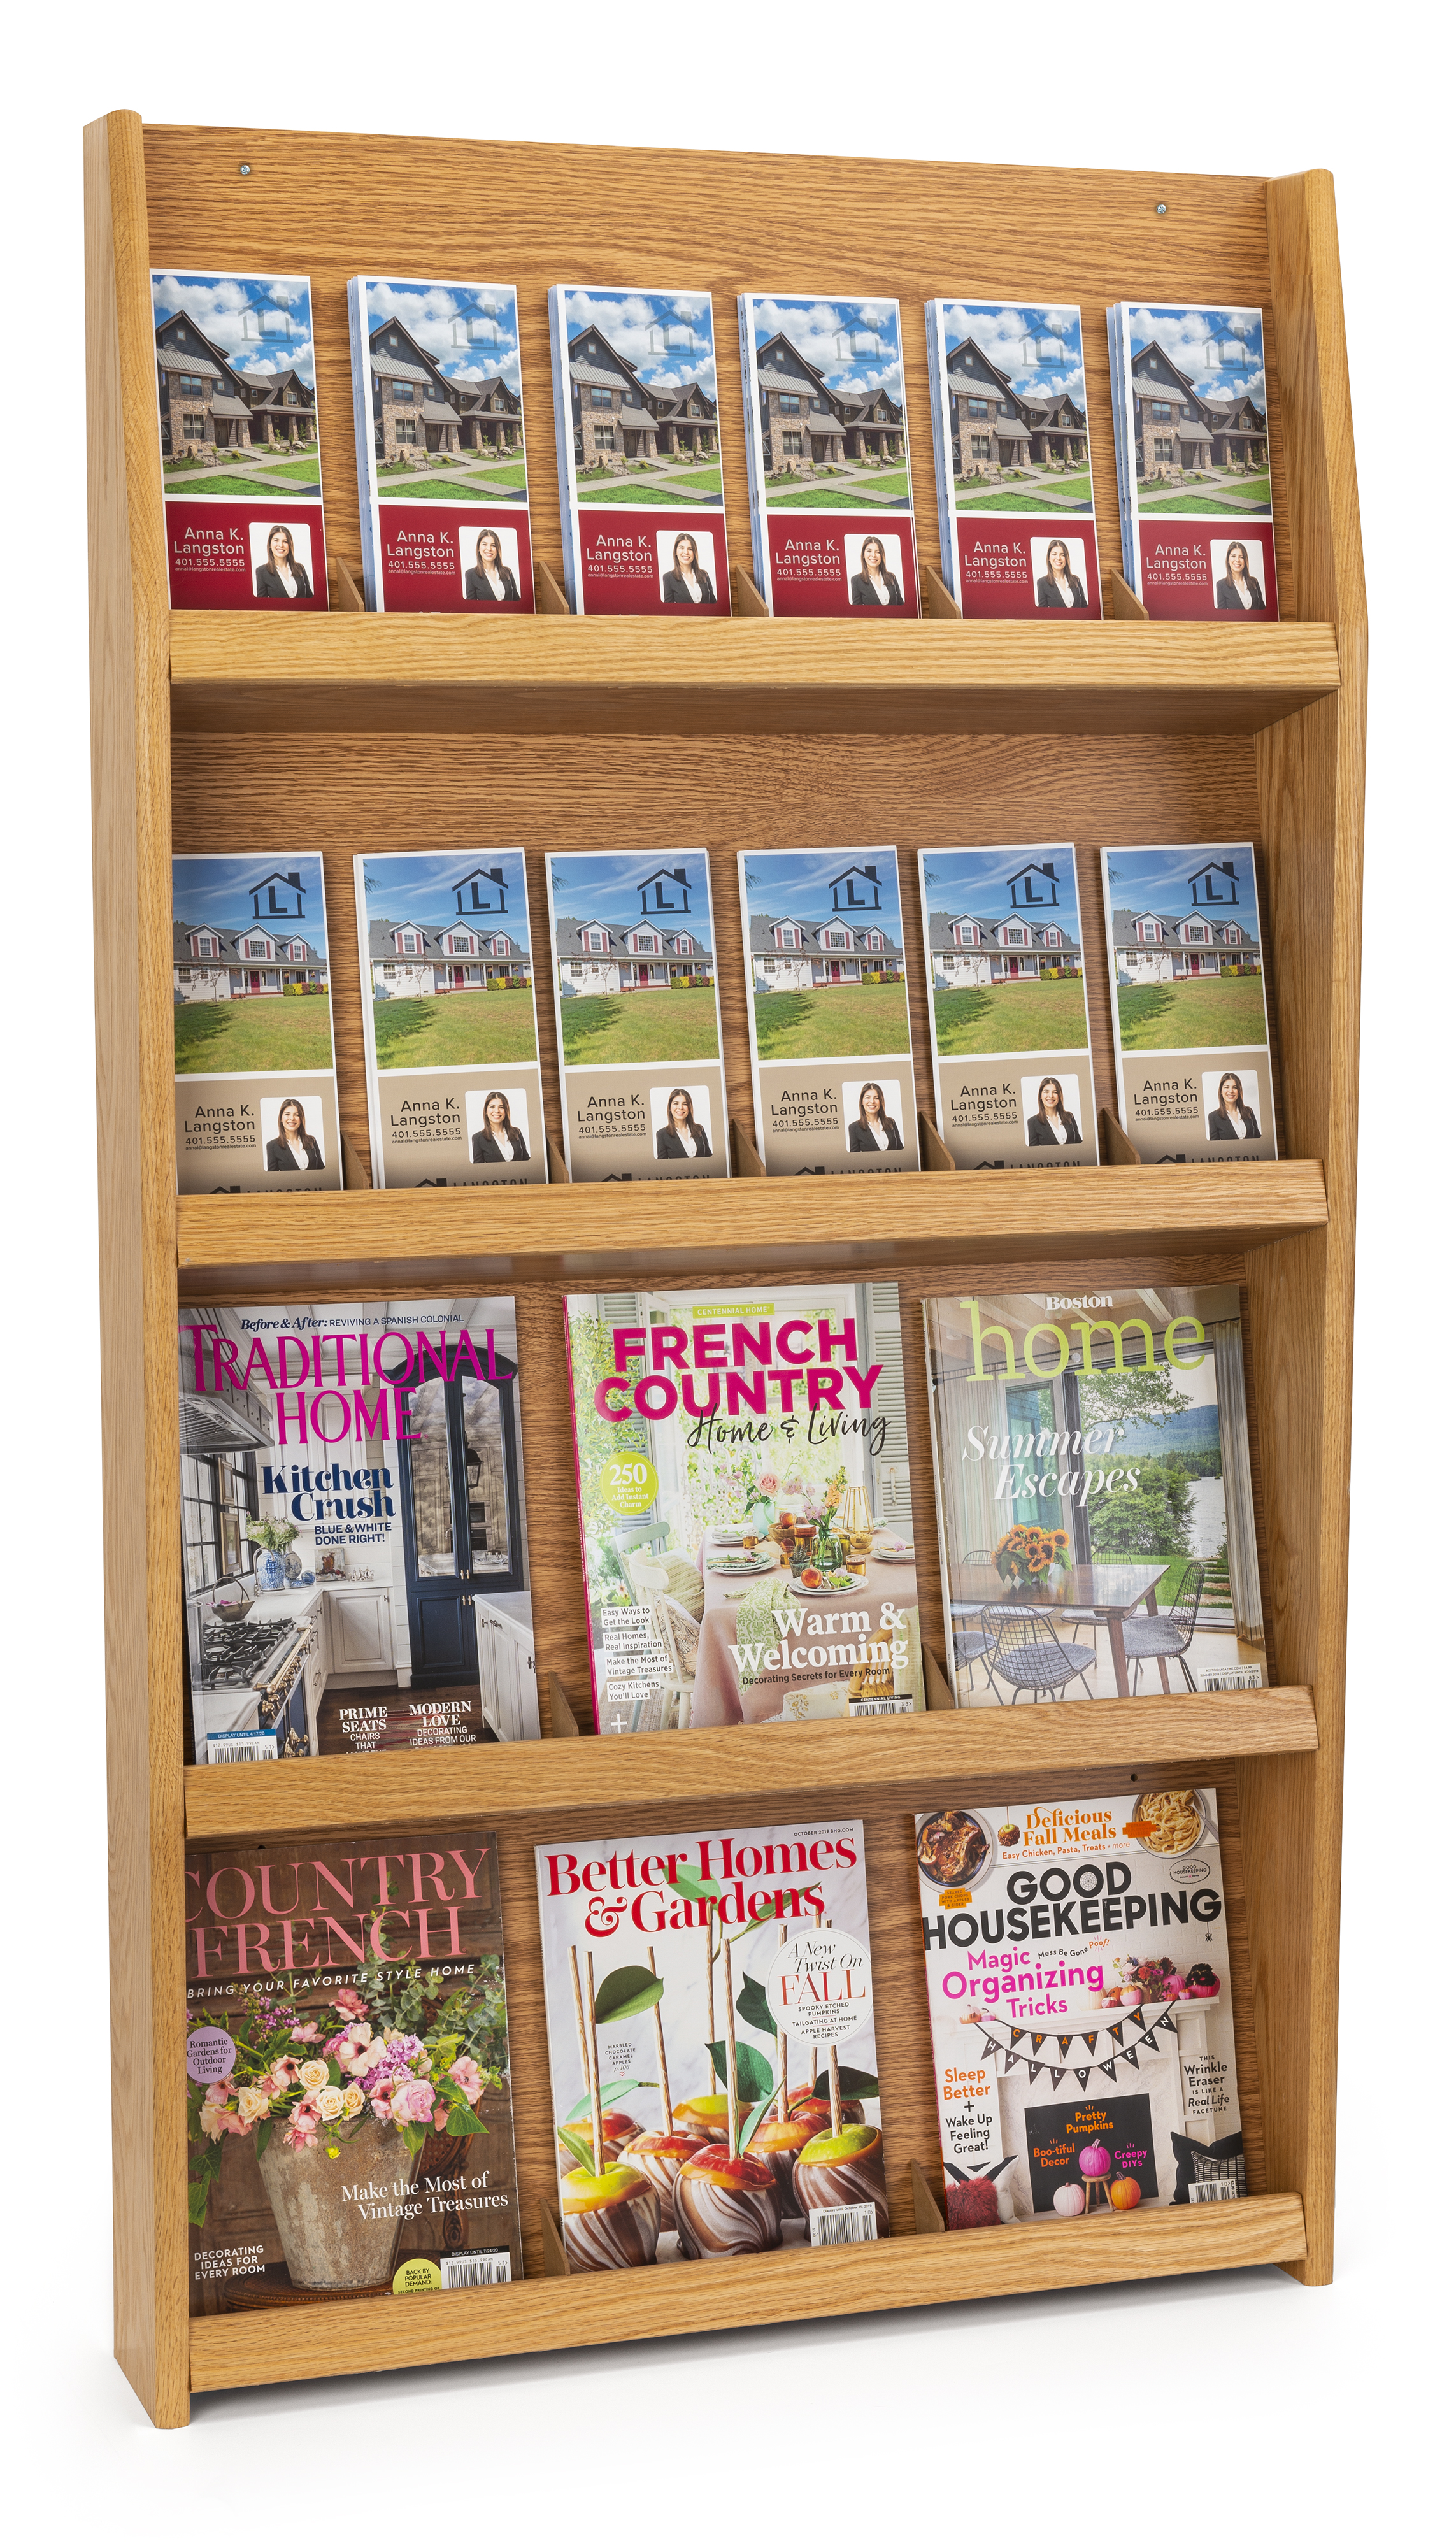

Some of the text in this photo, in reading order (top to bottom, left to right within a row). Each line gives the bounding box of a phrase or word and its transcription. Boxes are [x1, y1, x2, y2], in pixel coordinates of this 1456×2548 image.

[185, 527, 243, 540] Anna K.
[175, 541, 245, 555] Langston
[785, 540, 839, 551] Anna K.
[1155, 544, 1206, 556] Anna K.
[175, 558, 245, 567] 401.555.5555
[776, 552, 840, 566] Langston
[1146, 557, 1206, 571] Langston
[1143, 1079, 1197, 1092] Anna K.
[587, 1094, 645, 1108] Anna K.
[1134, 1091, 1198, 1106] Langston
[194, 1104, 255, 1119] Anna K.
[577, 1108, 645, 1124] Langston
[1135, 1107, 1198, 1117] 401.555.5555
[184, 1118, 255, 1135] Langston
[578, 1124, 645, 1134] 401.555.5555
[185, 1134, 255, 1145] 401.555.5555
[1046, 1296, 1113, 1310] Boston
[240, 1318, 279, 1332] Before
[281, 1317, 290, 1329] &
[291, 1317, 328, 1330] After:
[329, 1317, 370, 1327] REVIVING
[381, 1315, 418, 1326] SPANISH
[421, 1314, 464, 1324] COLONIAL
[613, 1318, 858, 1372] FRENCH
[960, 1301, 1205, 1382] home
[178, 1324, 513, 1391] TRADITIONAL
[594, 1364, 883, 1422] COUNTRY
[275, 1387, 421, 1445] HOME
[687, 1403, 892, 1456] Home & Living
[962, 1426, 1124, 1461] Summer
[261, 1462, 394, 1495] Kitchen
[609, 1463, 647, 1485] 250
[990, 1464, 1141, 1507] Escapes
[291, 1490, 396, 1521] Crush
[315, 1522, 392, 1534] BLUE & WHITE
[315, 1533, 385, 1545] DONE RIGHT!
[771, 1603, 906, 1638] Warm &
[728, 1633, 908, 1673] Welcoming
[743, 1666, 890, 1685] Decorating Secrets for Every Room
[339, 1707, 387, 1720] PRIME
[409, 1701, 471, 1715] MODERN
[342, 1719, 386, 1733] SEATS
[422, 1714, 460, 1727] LOVE
[350, 1732, 380, 1741] CHAIRS
[1026, 1807, 1111, 1829] Delicious
[1023, 1828, 1058, 1847] Fall
[1063, 1824, 1117, 1843] Meals
[1022, 1849, 1055, 1857] Chicken,
[1082, 1843, 1106, 1852] Treats
[545, 1838, 857, 1897] Better Homes
[1007, 1861, 1131, 1905] GOOD
[585, 1881, 825, 1938] & Gardens
[924, 1888, 1221, 1950] HOUSEKEEPING
[189, 1906, 466, 1979] FRENCH
[787, 1941, 836, 1958] A New
[794, 1953, 864, 1973] Twist On
[967, 1946, 1031, 1973] Magic
[187, 1964, 475, 1999] BRING YOUR FAVORITE STYLE HOME
[777, 1969, 866, 2006] FALL
[942, 1961, 1104, 2003] Organizing
[1006, 1993, 1068, 2019] Tricks
[792, 2017, 827, 2026] TAILGATING
[190, 2038, 227, 2048] Romantic
[187, 2048, 219, 2058] Gardens
[193, 2056, 226, 2065] Outdoor
[198, 2066, 222, 2074] Living
[1184, 2061, 1227, 2075] Wrinkle
[945, 2068, 986, 2085] Sleep
[1189, 2077, 1225, 2087] Eraser
[943, 2084, 991, 2100] Better
[1188, 2094, 1229, 2107] Real Life
[945, 2114, 992, 2128] Wake Up
[1075, 2110, 1106, 2123] Pretty
[950, 2128, 990, 2142] Feeling
[1066, 2121, 1113, 2134] Pumpkins
[953, 2140, 989, 2154] Great!
[1034, 2143, 1075, 2158] Boo-tiful
[1041, 2155, 1069, 2167] Decor
[1114, 2150, 1147, 2162] Creepy
[1122, 2159, 1143, 2168] DIYs
[341, 2171, 490, 2202] Make the Most of
[358, 2193, 508, 2221] Vintage Treasures
